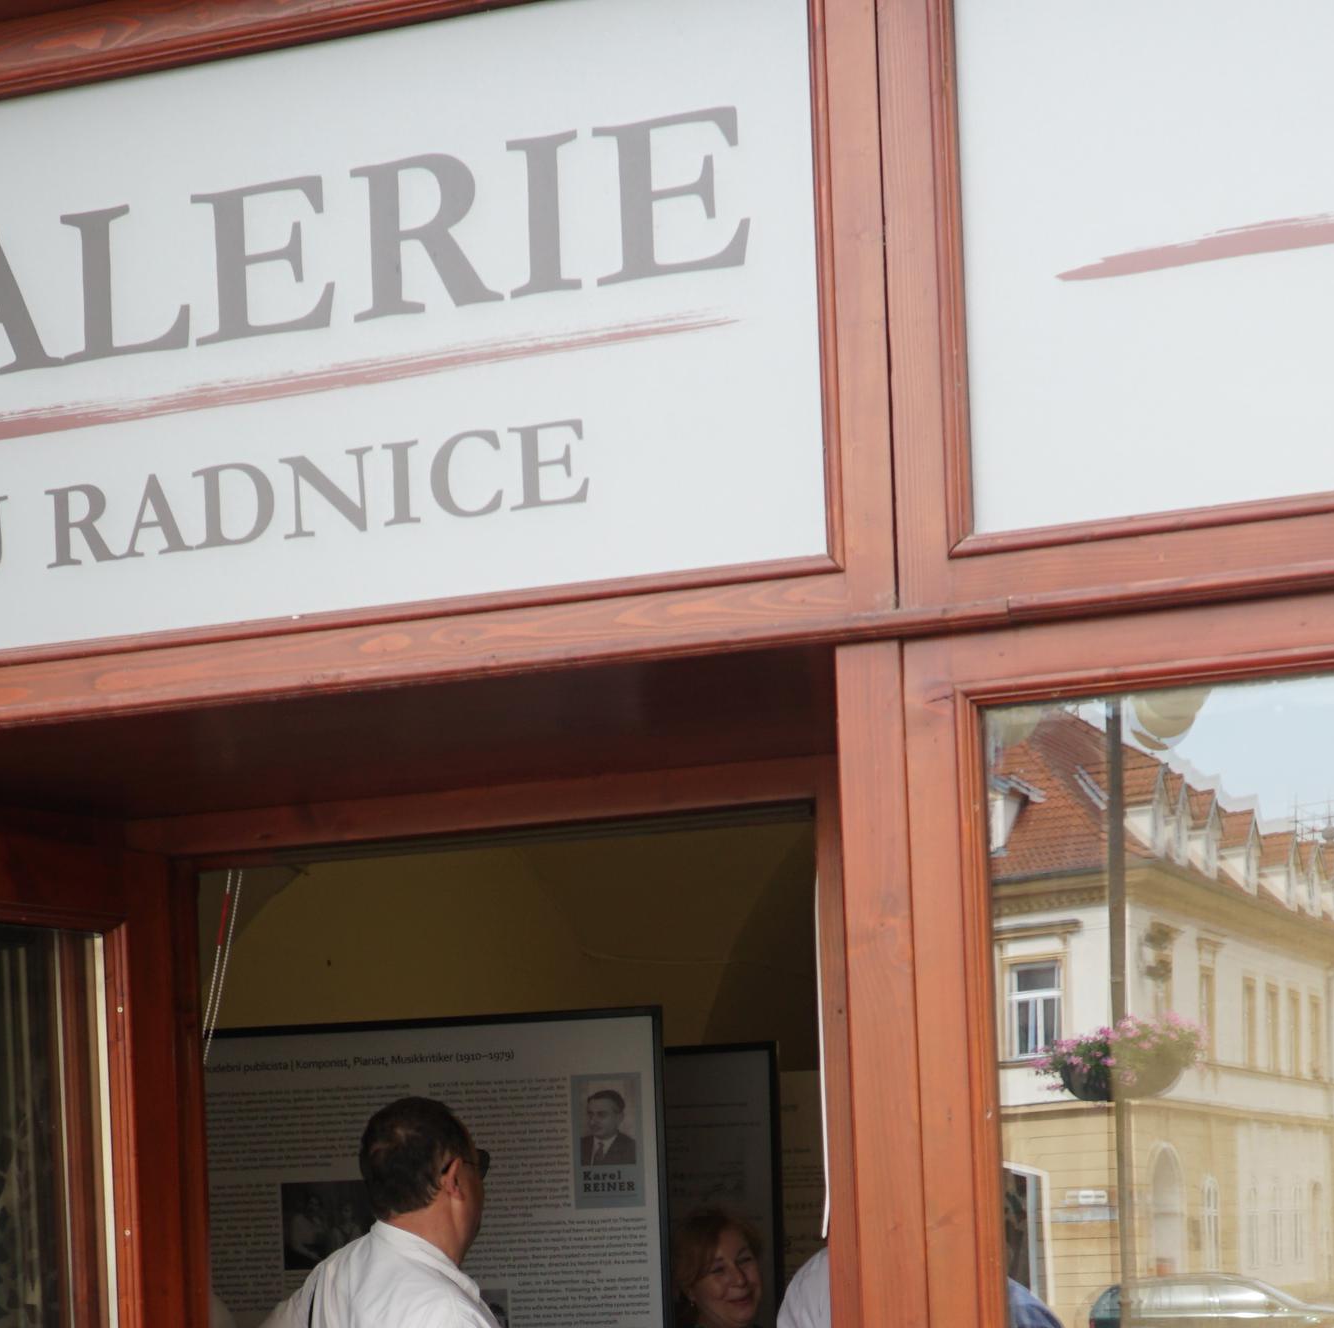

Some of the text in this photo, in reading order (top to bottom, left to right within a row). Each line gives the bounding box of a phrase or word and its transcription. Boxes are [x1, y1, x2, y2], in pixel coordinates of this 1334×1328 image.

[46, 417, 591, 570] RADNICE
[582, 1170, 622, 1181] Karel
[583, 1180, 636, 1193] REINER
